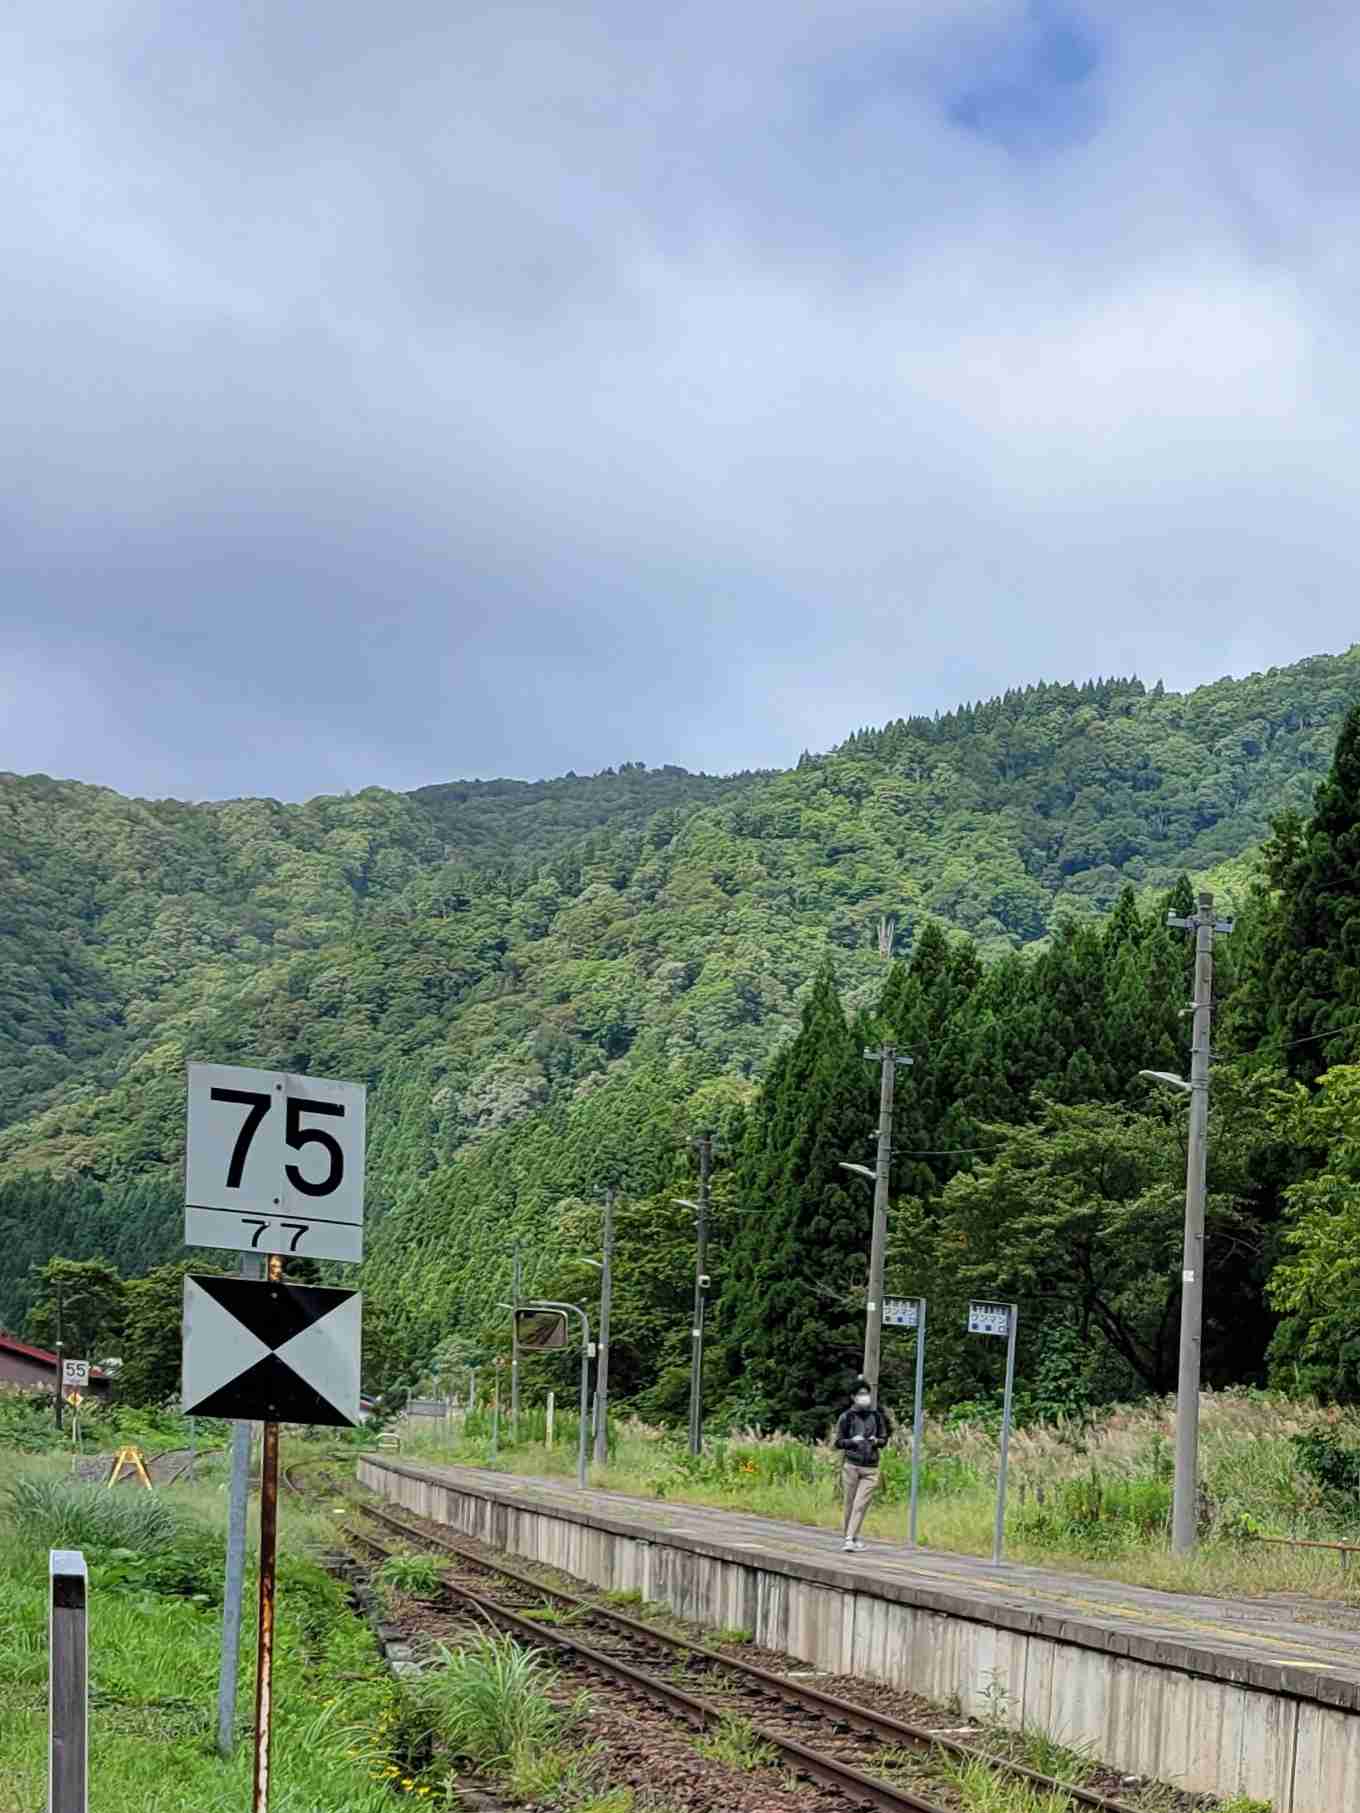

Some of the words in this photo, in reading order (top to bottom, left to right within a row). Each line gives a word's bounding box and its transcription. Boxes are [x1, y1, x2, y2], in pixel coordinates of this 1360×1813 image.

[210, 1086, 345, 1197] 75
[241, 1219, 309, 1252] 77
[66, 1363, 86, 1377] 55
